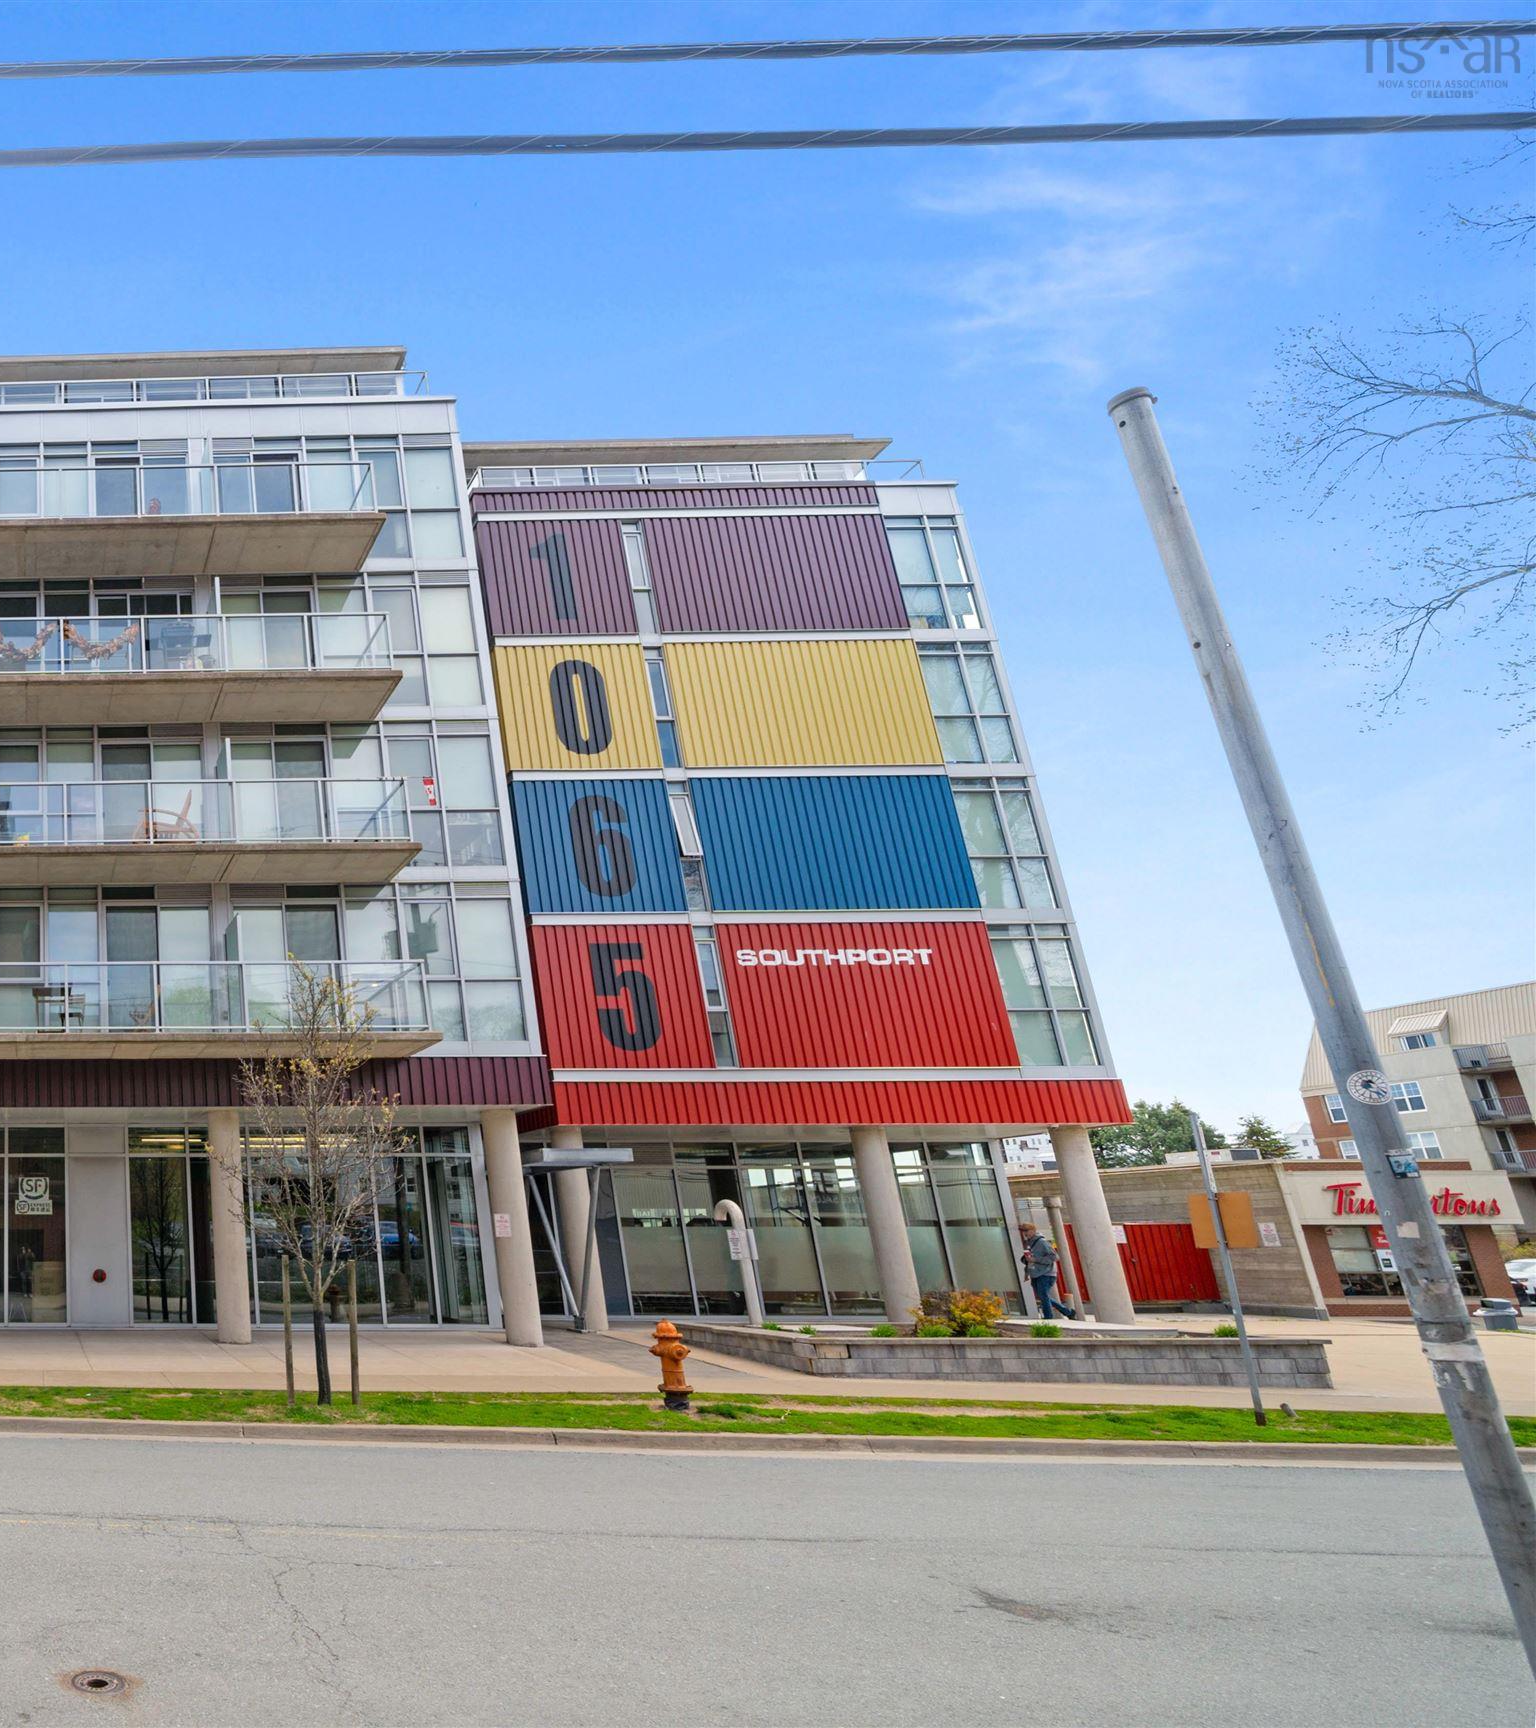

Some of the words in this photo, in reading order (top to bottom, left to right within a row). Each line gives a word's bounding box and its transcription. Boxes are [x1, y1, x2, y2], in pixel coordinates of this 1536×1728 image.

[736, 949, 933, 966] SOUTHPORT
[25, 1179, 42, 1193] SF
[1431, 1187, 1502, 1217] rtons
